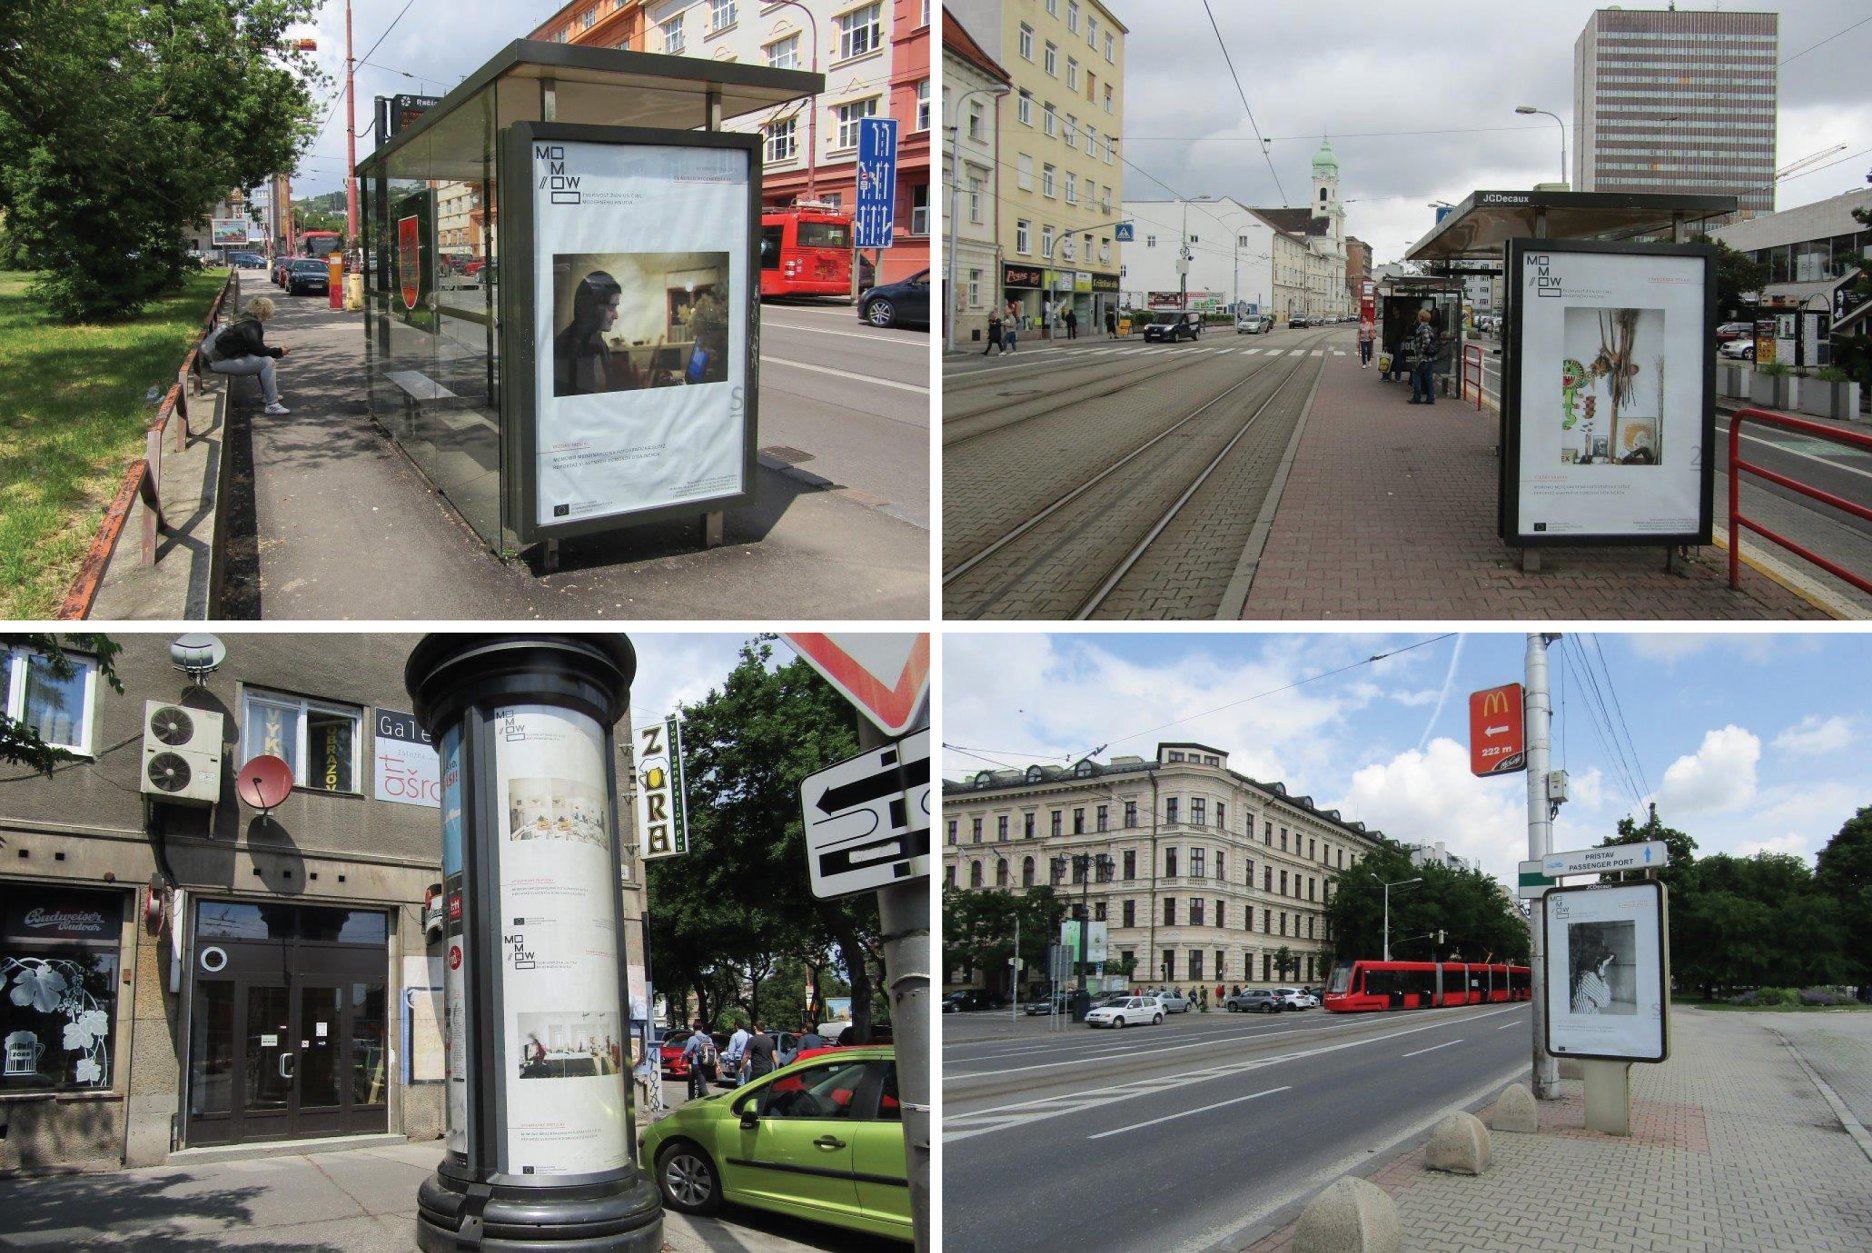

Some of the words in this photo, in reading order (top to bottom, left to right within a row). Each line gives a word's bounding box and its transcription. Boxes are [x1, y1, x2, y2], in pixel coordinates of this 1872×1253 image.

[1483, 194, 1529, 202] JCDecaux
[1481, 747, 1500, 757] 222
[1502, 745, 1512, 753] m
[671, 755, 681, 825] generation
[1568, 861, 1612, 872] PASSENGER
[1613, 858, 1634, 867] PORT
[24, 907, 105, 928] Budweiser
[58, 919, 102, 931] Budvar
